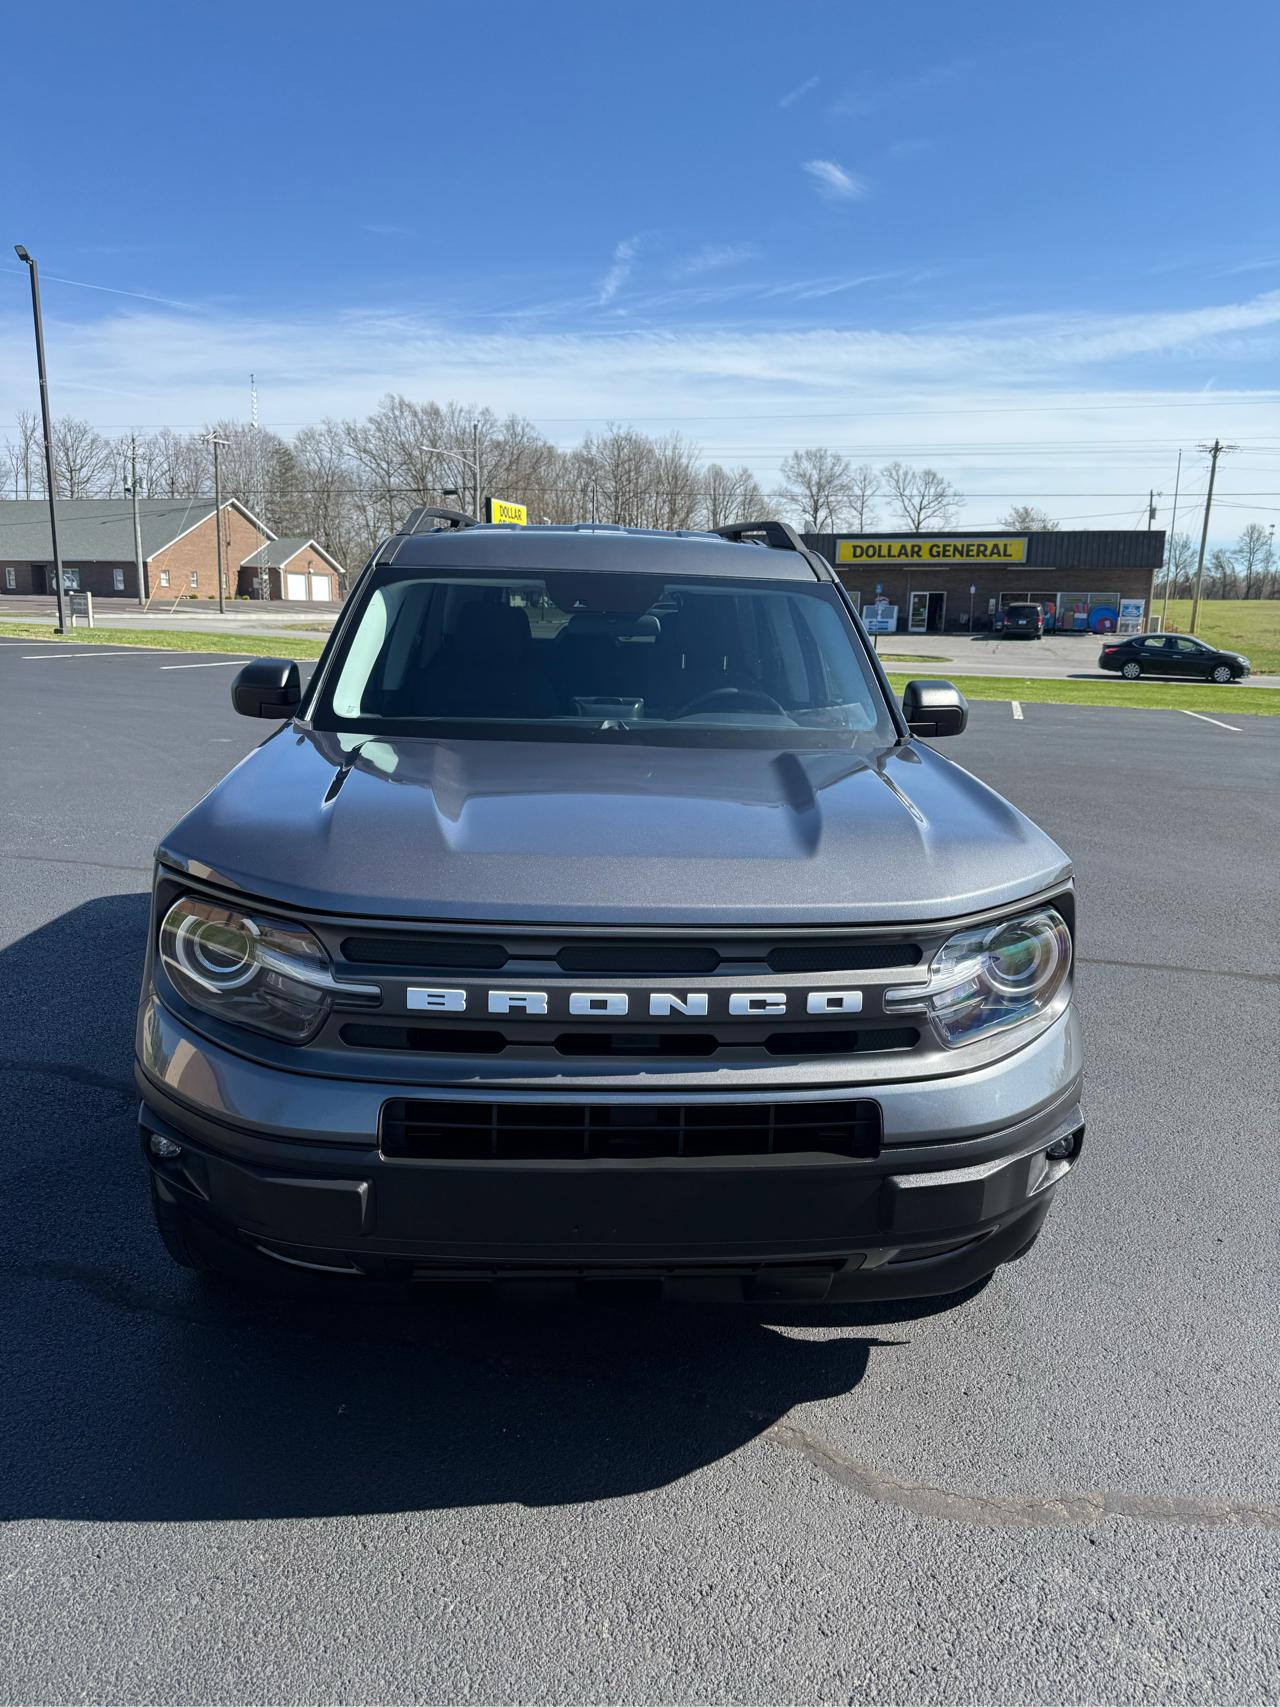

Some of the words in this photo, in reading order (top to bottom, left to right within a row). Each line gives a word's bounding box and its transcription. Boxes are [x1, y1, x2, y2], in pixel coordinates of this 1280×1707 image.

[499, 505, 523, 521] DOLLAR
[851, 544, 922, 558] DOLLAR
[929, 543, 1013, 558] GENERAL
[406, 987, 863, 1016] BRONCO
